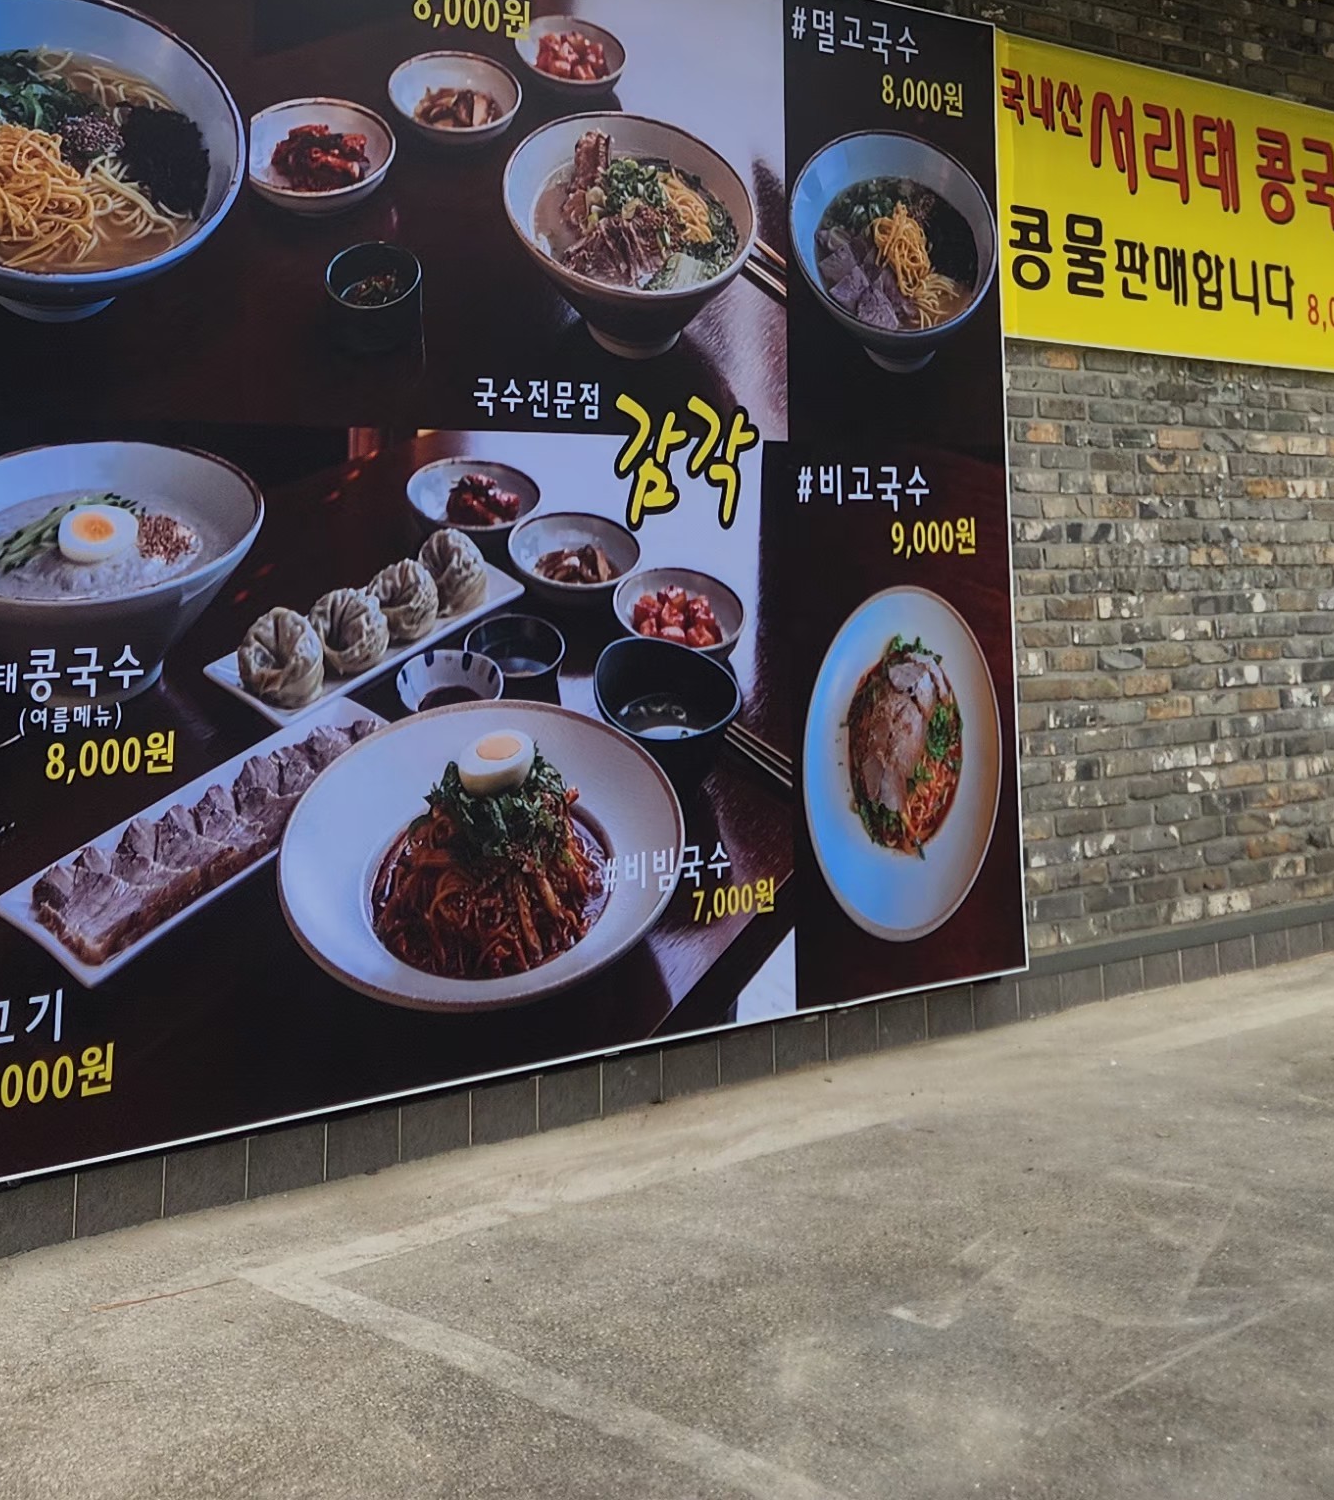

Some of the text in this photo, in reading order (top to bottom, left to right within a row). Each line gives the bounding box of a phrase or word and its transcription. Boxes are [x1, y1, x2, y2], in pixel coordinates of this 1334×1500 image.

[791, 6, 919, 64] #멸고국수
[880, 75, 964, 118] 8,000원
[473, 377, 760, 528] 국수전문점 감각
[797, 465, 930, 512] #비고국수
[890, 517, 976, 559] 9,000원
[19, 702, 123, 736] (여름메뉴)
[45, 731, 176, 783] 8,000원
[692, 877, 775, 924] 7,000원
